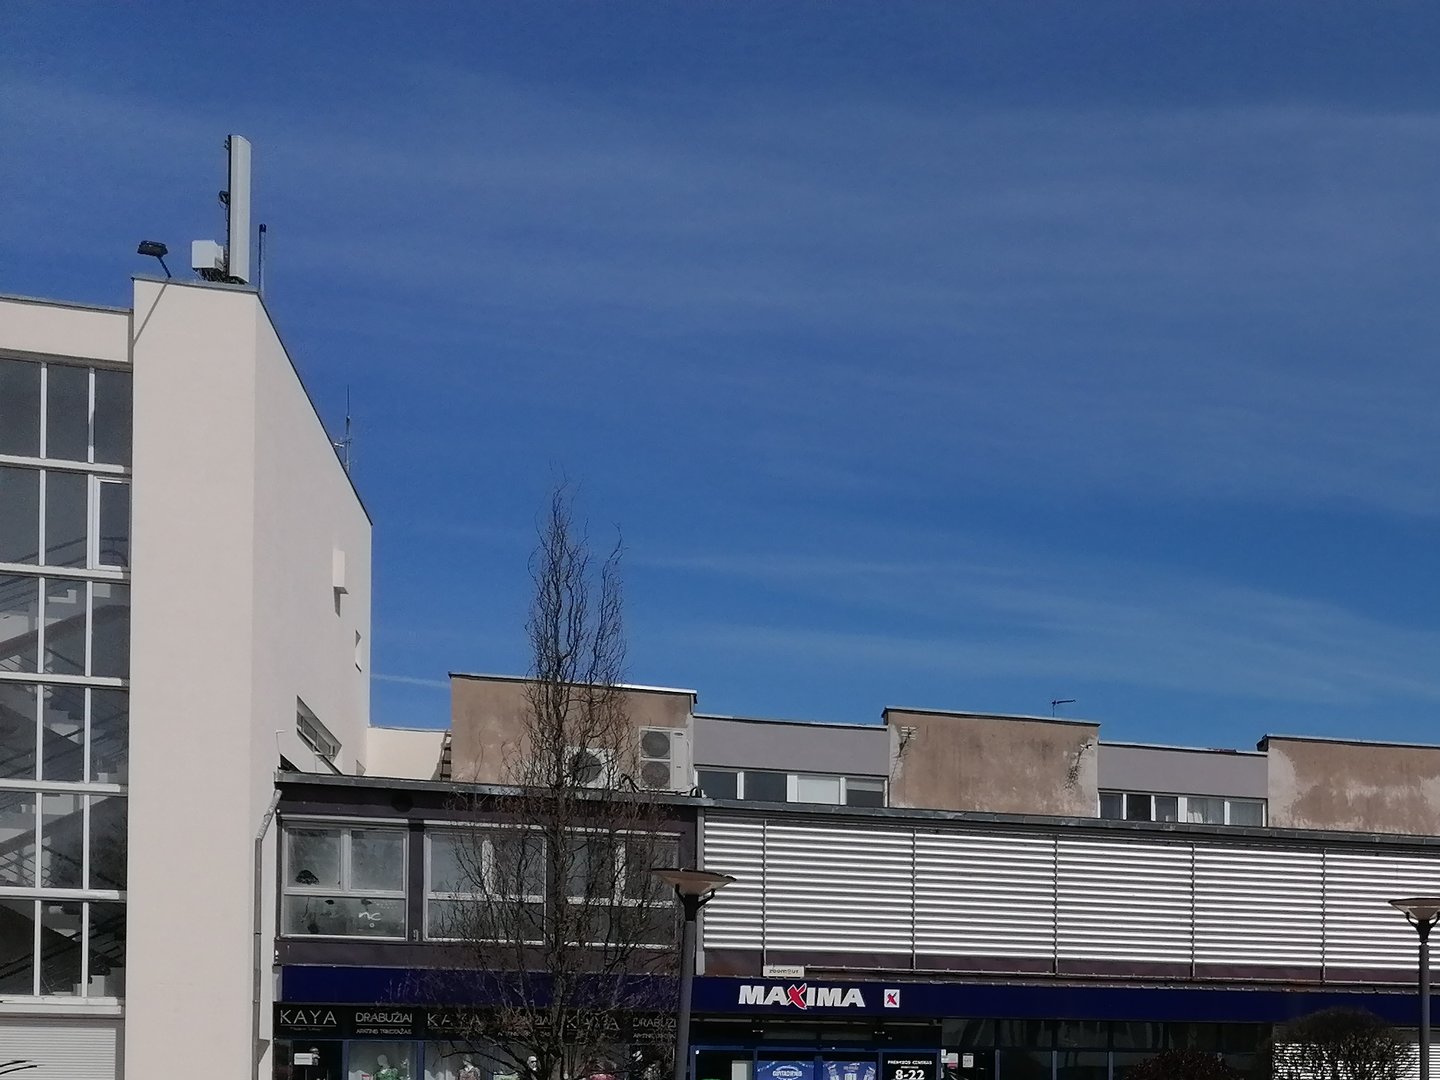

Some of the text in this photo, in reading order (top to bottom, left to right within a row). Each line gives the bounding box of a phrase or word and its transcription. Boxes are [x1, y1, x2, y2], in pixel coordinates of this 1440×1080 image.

[738, 983, 866, 1010] MAXIMA
[280, 1009, 337, 1024] KAYA
[355, 1011, 413, 1023] DRABUŽIAI
[895, 1069, 925, 1080] 8-22
